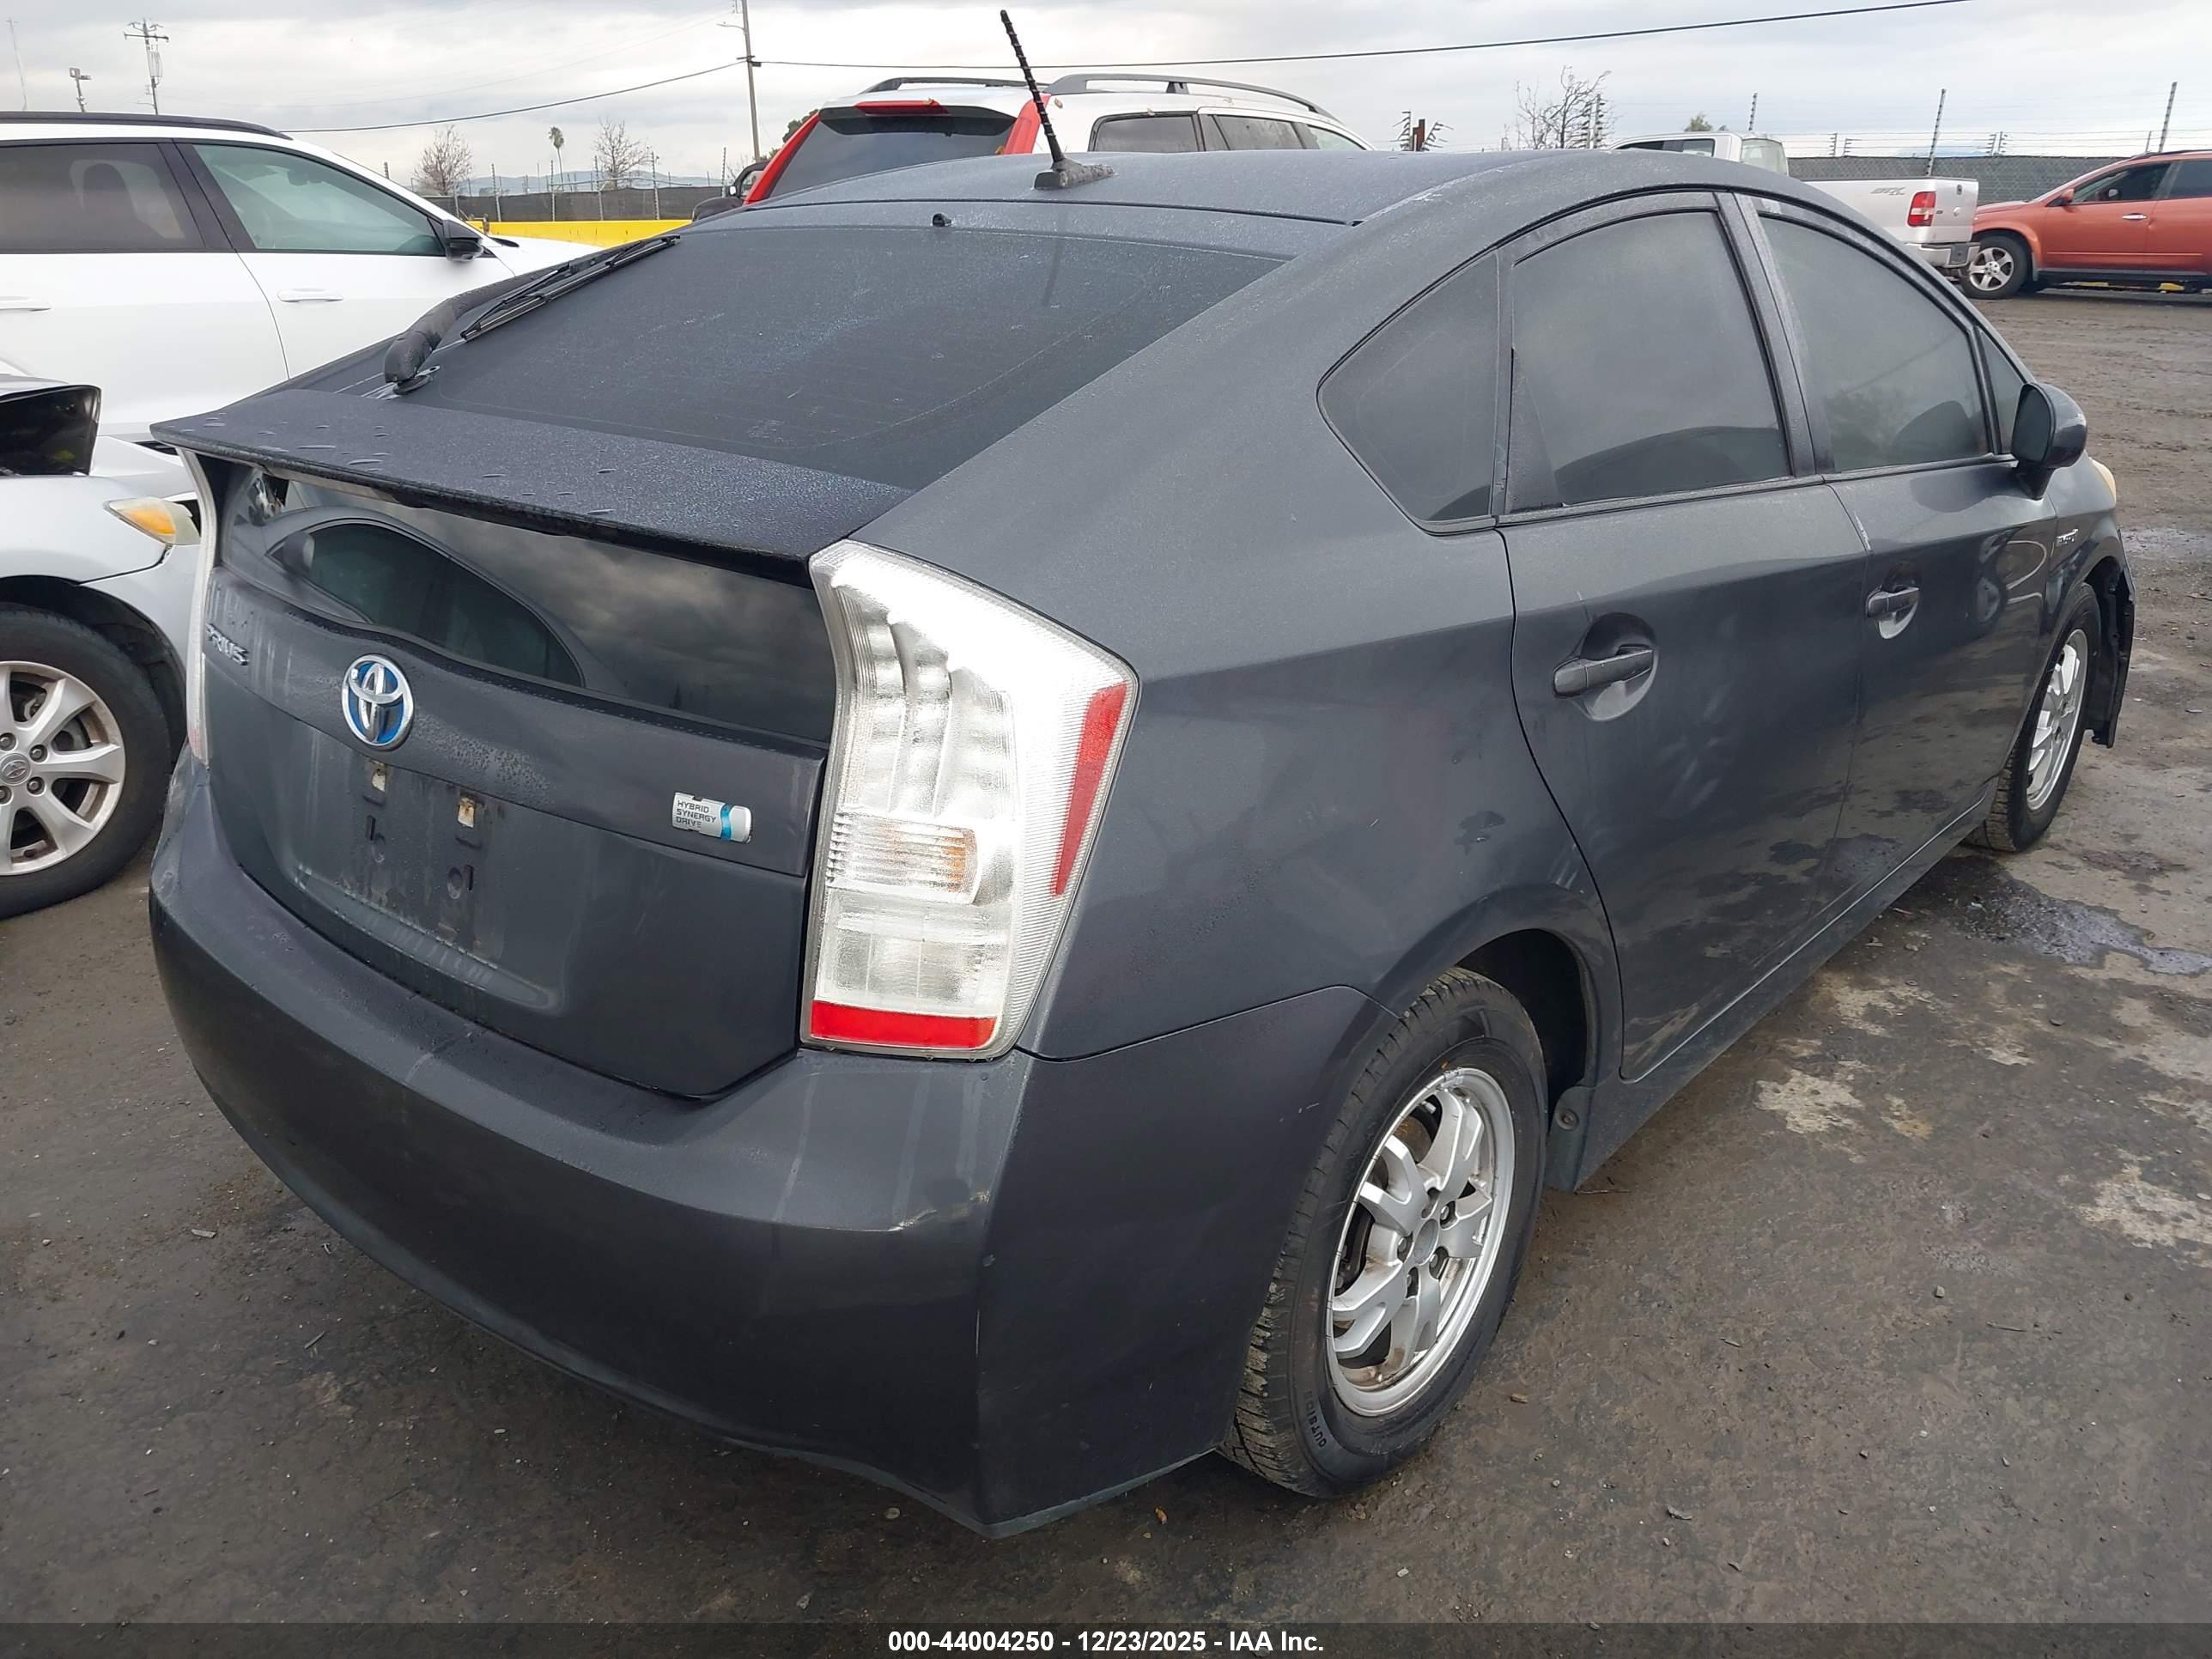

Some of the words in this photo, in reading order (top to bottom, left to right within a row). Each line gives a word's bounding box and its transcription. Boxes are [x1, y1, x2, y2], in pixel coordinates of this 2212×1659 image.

[677, 799, 709, 814] HYBRID
[675, 816, 702, 829] DRIVE
[676, 808, 716, 823] SYNERGY
